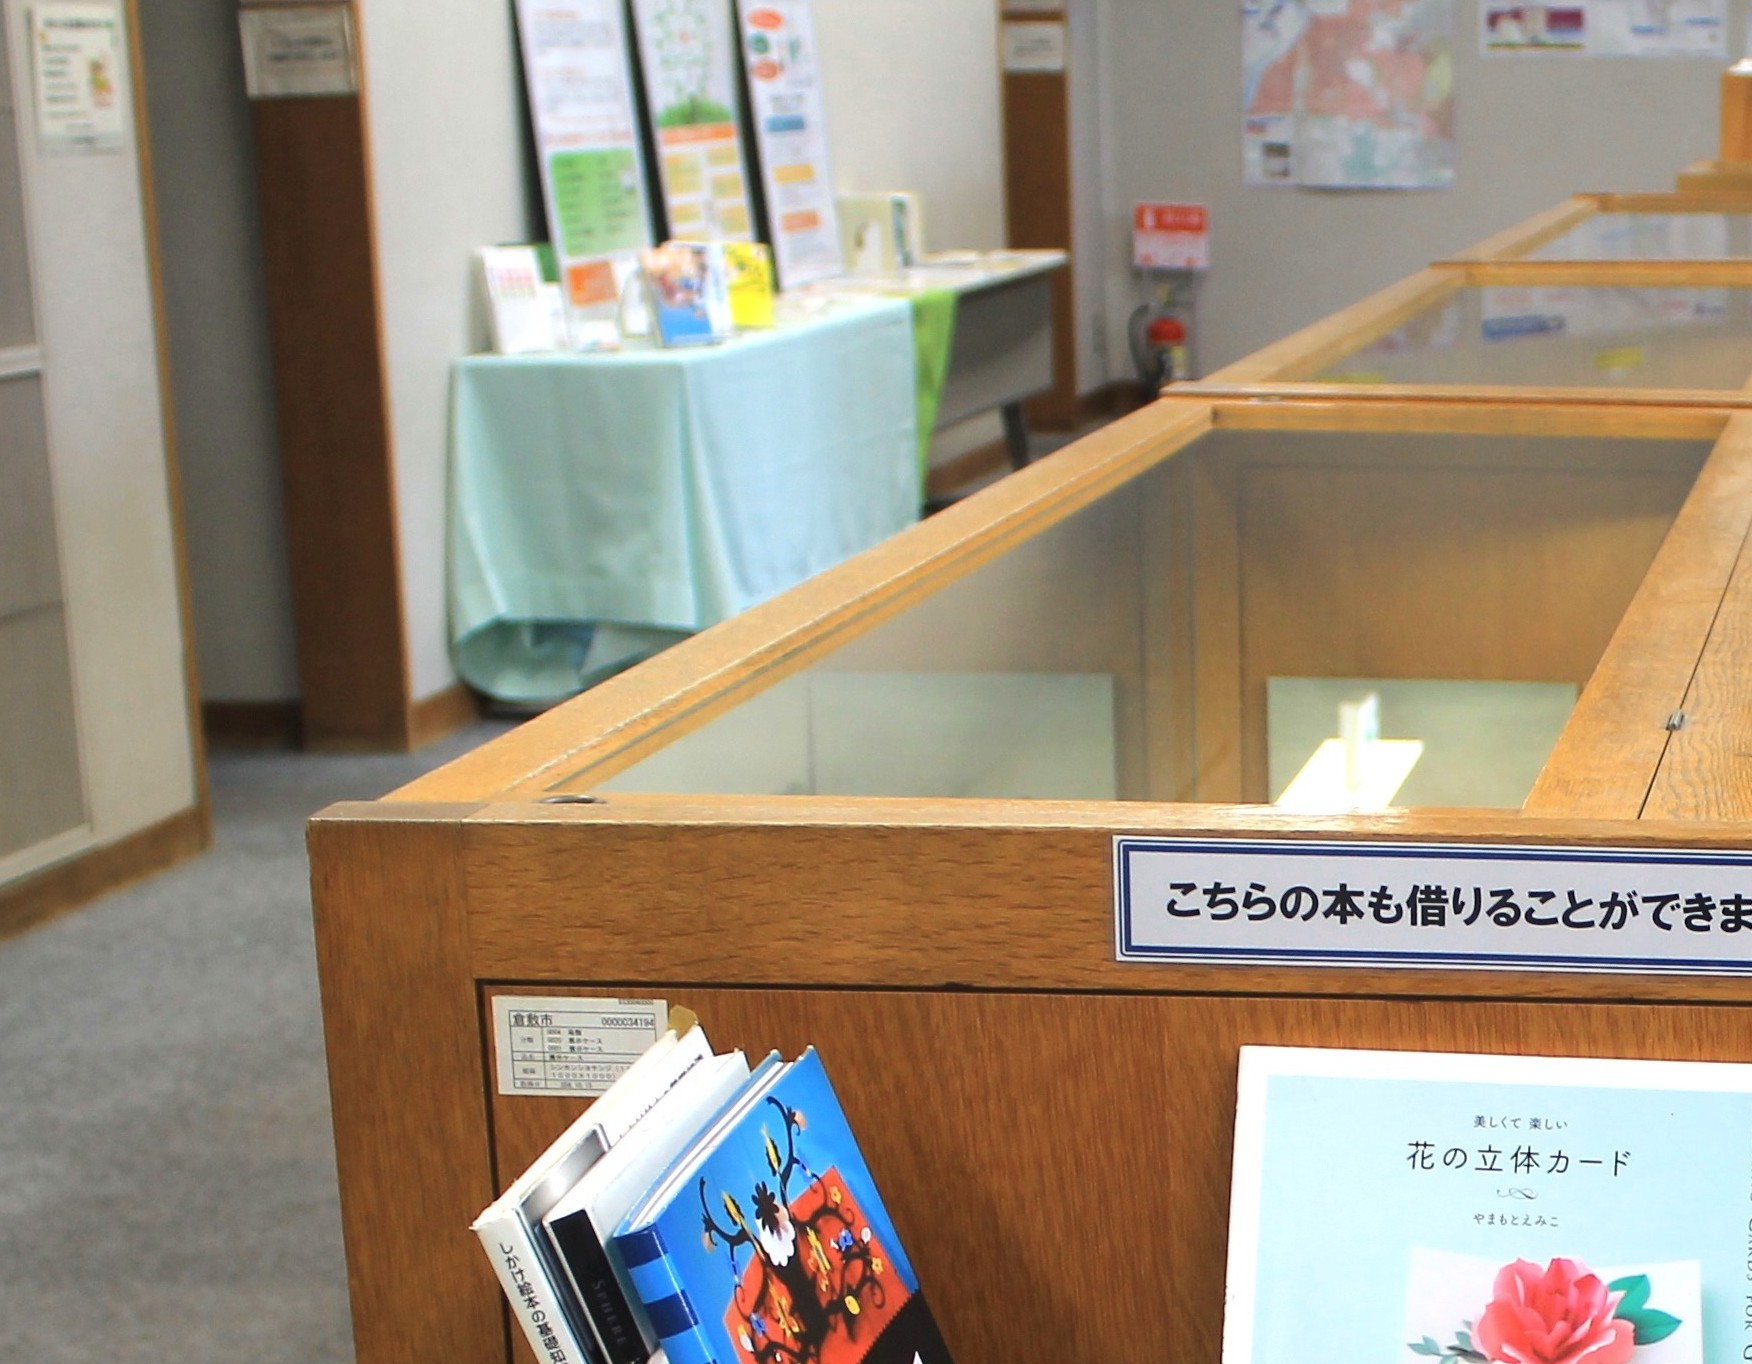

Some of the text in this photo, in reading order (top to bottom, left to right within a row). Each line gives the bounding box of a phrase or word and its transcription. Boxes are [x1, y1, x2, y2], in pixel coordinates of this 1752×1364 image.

[512, 1012, 553, 1026] 倉敷市
[1473, 1114, 1569, 1131] 美しくて 楽しい
[1405, 1140, 1632, 1177] 花の立体カード
[1472, 1212, 1560, 1228] やまもとえみこ
